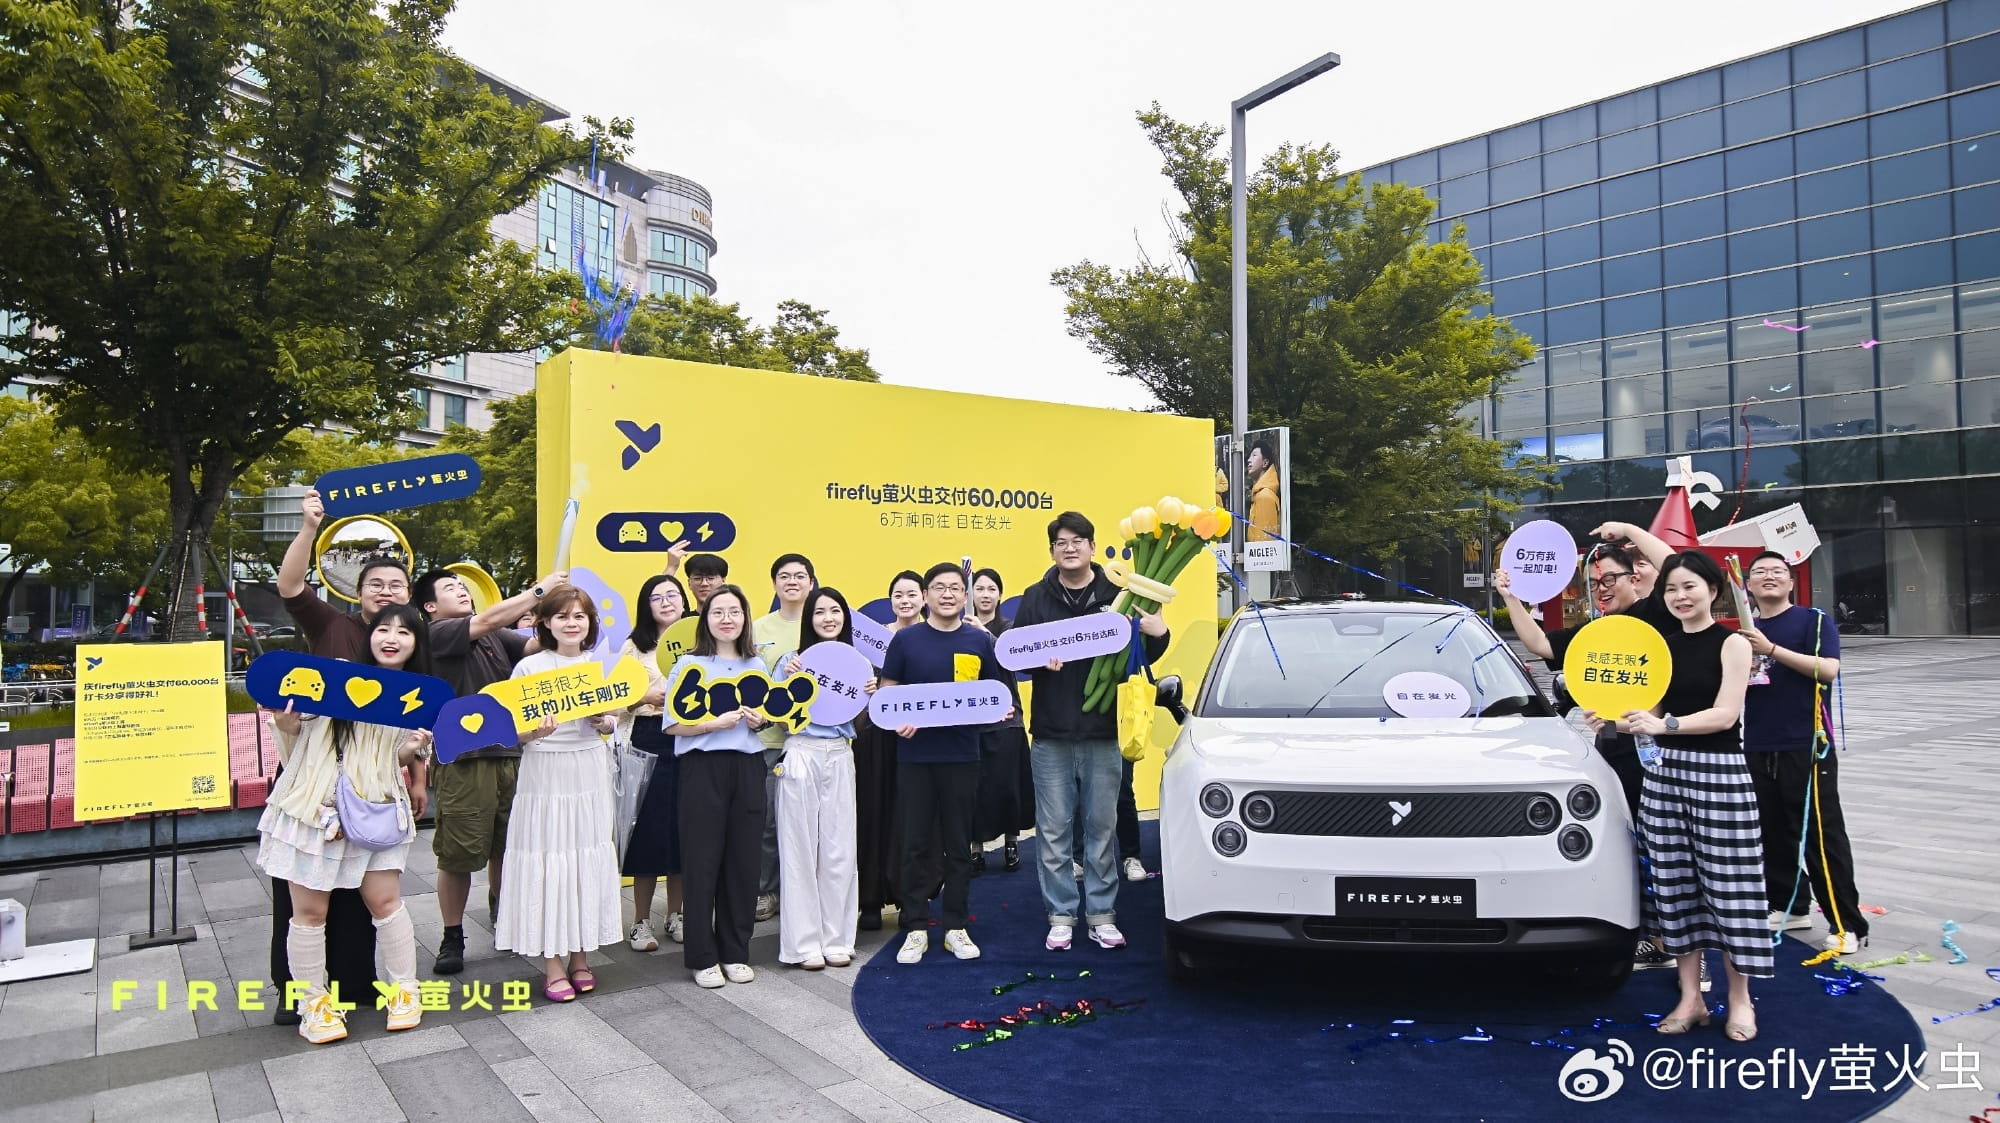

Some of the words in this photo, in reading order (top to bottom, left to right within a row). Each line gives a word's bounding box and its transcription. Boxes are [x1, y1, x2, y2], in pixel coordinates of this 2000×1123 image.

[826, 482, 1053, 510] firefly萤火虫交付60,000台
[880, 511, 951, 529] 6万种向往
[957, 513, 1012, 530] 自在发光
[1516, 548, 1556, 561] 6万有我
[1513, 563, 1557, 574] 一起加电!
[666, 640, 682, 652] in
[1586, 651, 1637, 666] 灵感无限
[1584, 667, 1649, 686] 自在发光
[518, 672, 592, 702] 上海很大
[522, 681, 631, 722] 我的小车刚好
